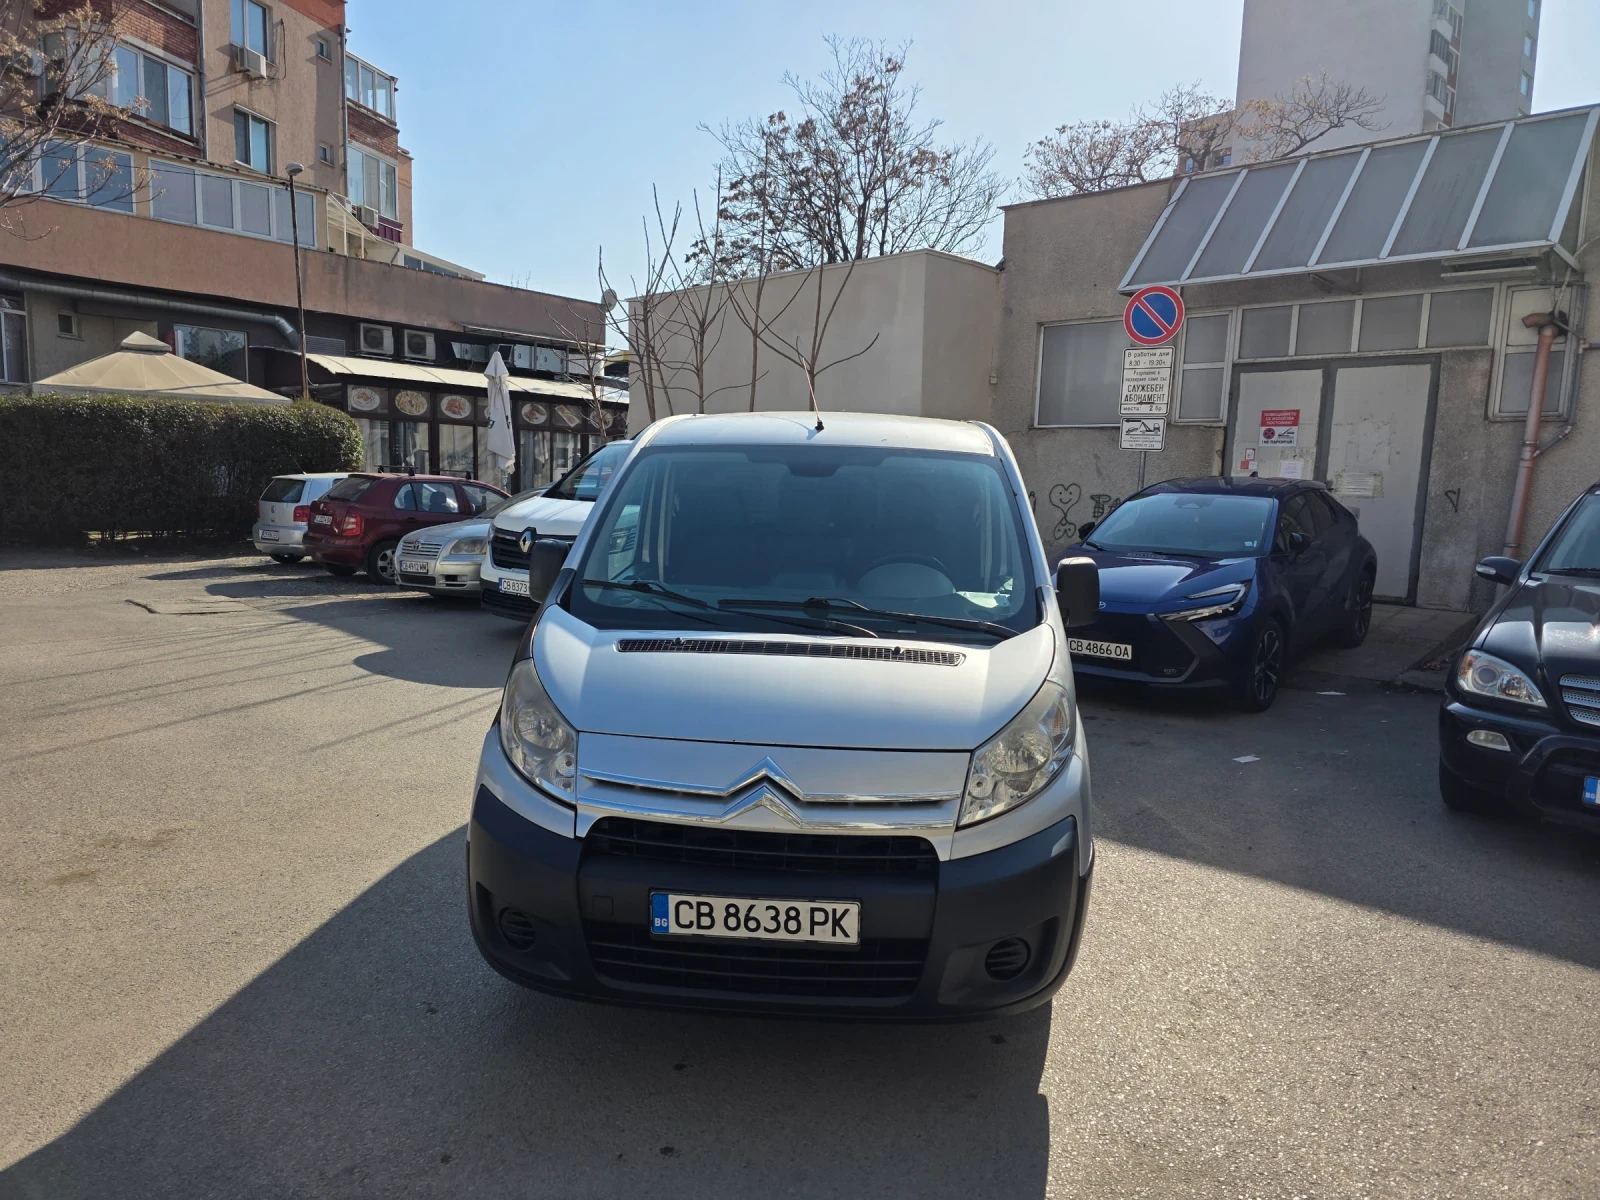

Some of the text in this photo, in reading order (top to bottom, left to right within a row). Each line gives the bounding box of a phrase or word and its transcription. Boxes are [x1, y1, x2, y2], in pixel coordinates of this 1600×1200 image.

[1133, 351, 1157, 359] работни
[1127, 383, 1164, 393] СЛУЖЕБЕН
[1124, 393, 1166, 402] АБОНАМЕНТ
[503, 580, 528, 593] CB 8373
[1069, 640, 1130, 658] CB 4866 OA
[654, 900, 851, 938] BG CB 8638 PK
